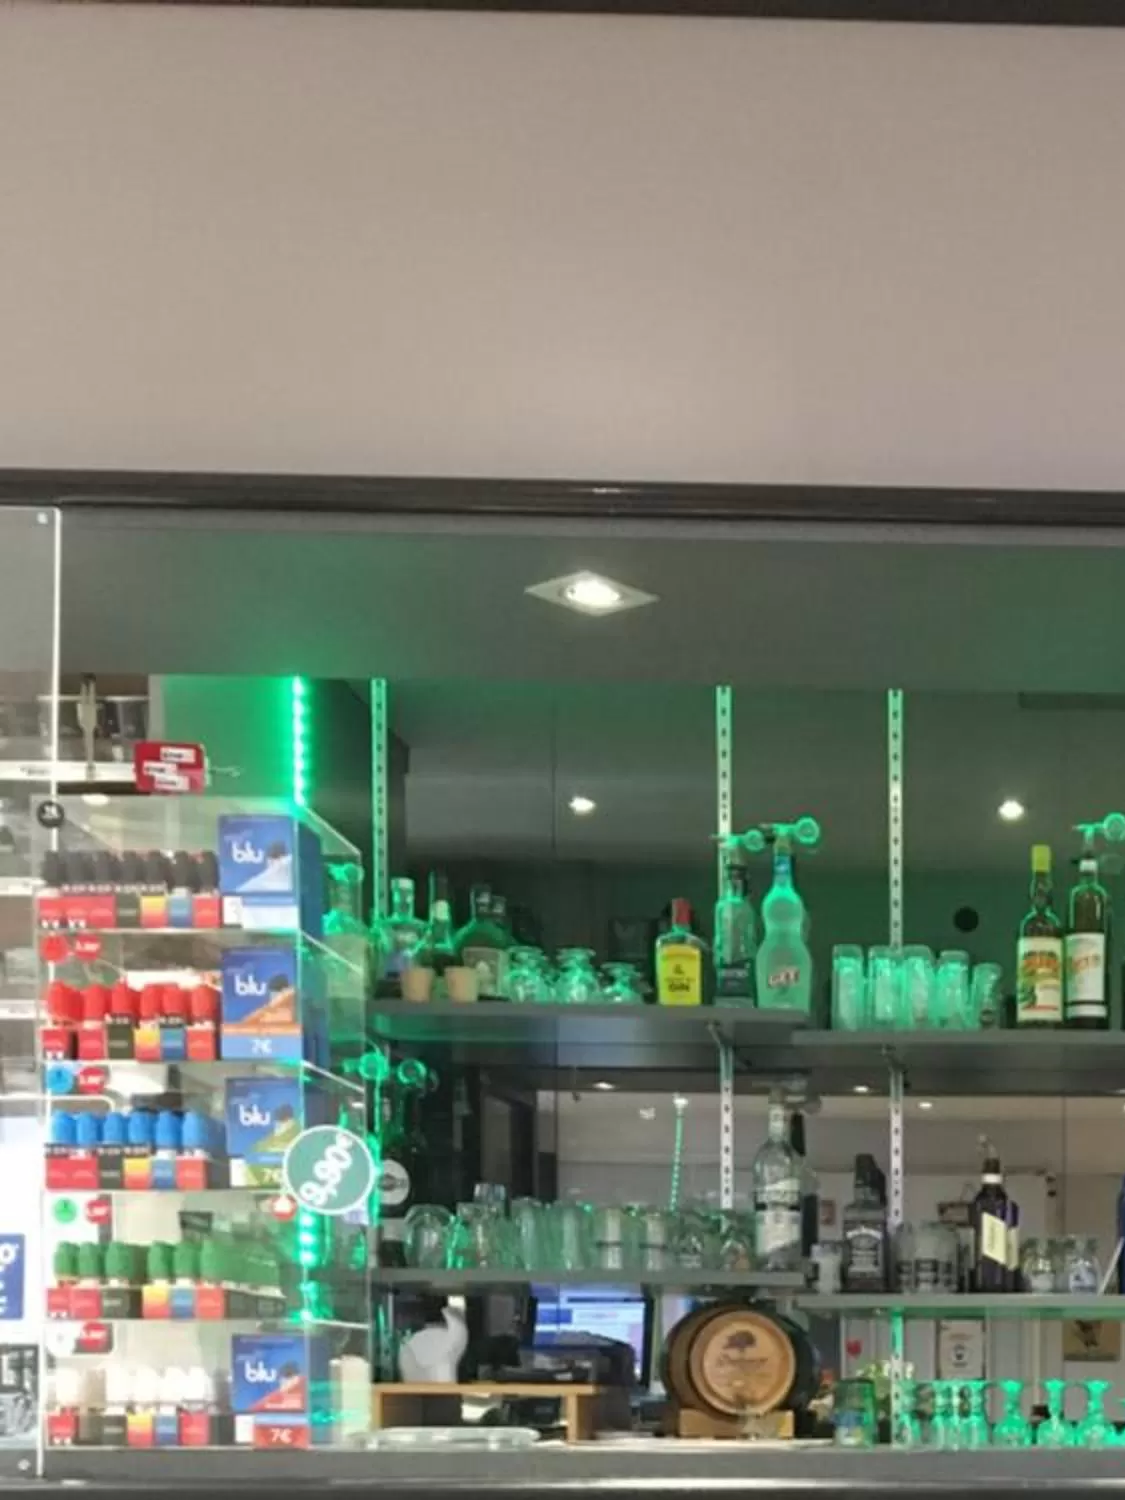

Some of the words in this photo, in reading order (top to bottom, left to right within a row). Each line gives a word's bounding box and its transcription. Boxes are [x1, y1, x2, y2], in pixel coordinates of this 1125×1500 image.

[231, 840, 264, 865] blu
[234, 974, 267, 997] blu
[239, 1103, 272, 1127] blu
[244, 1360, 277, 1384] blu
